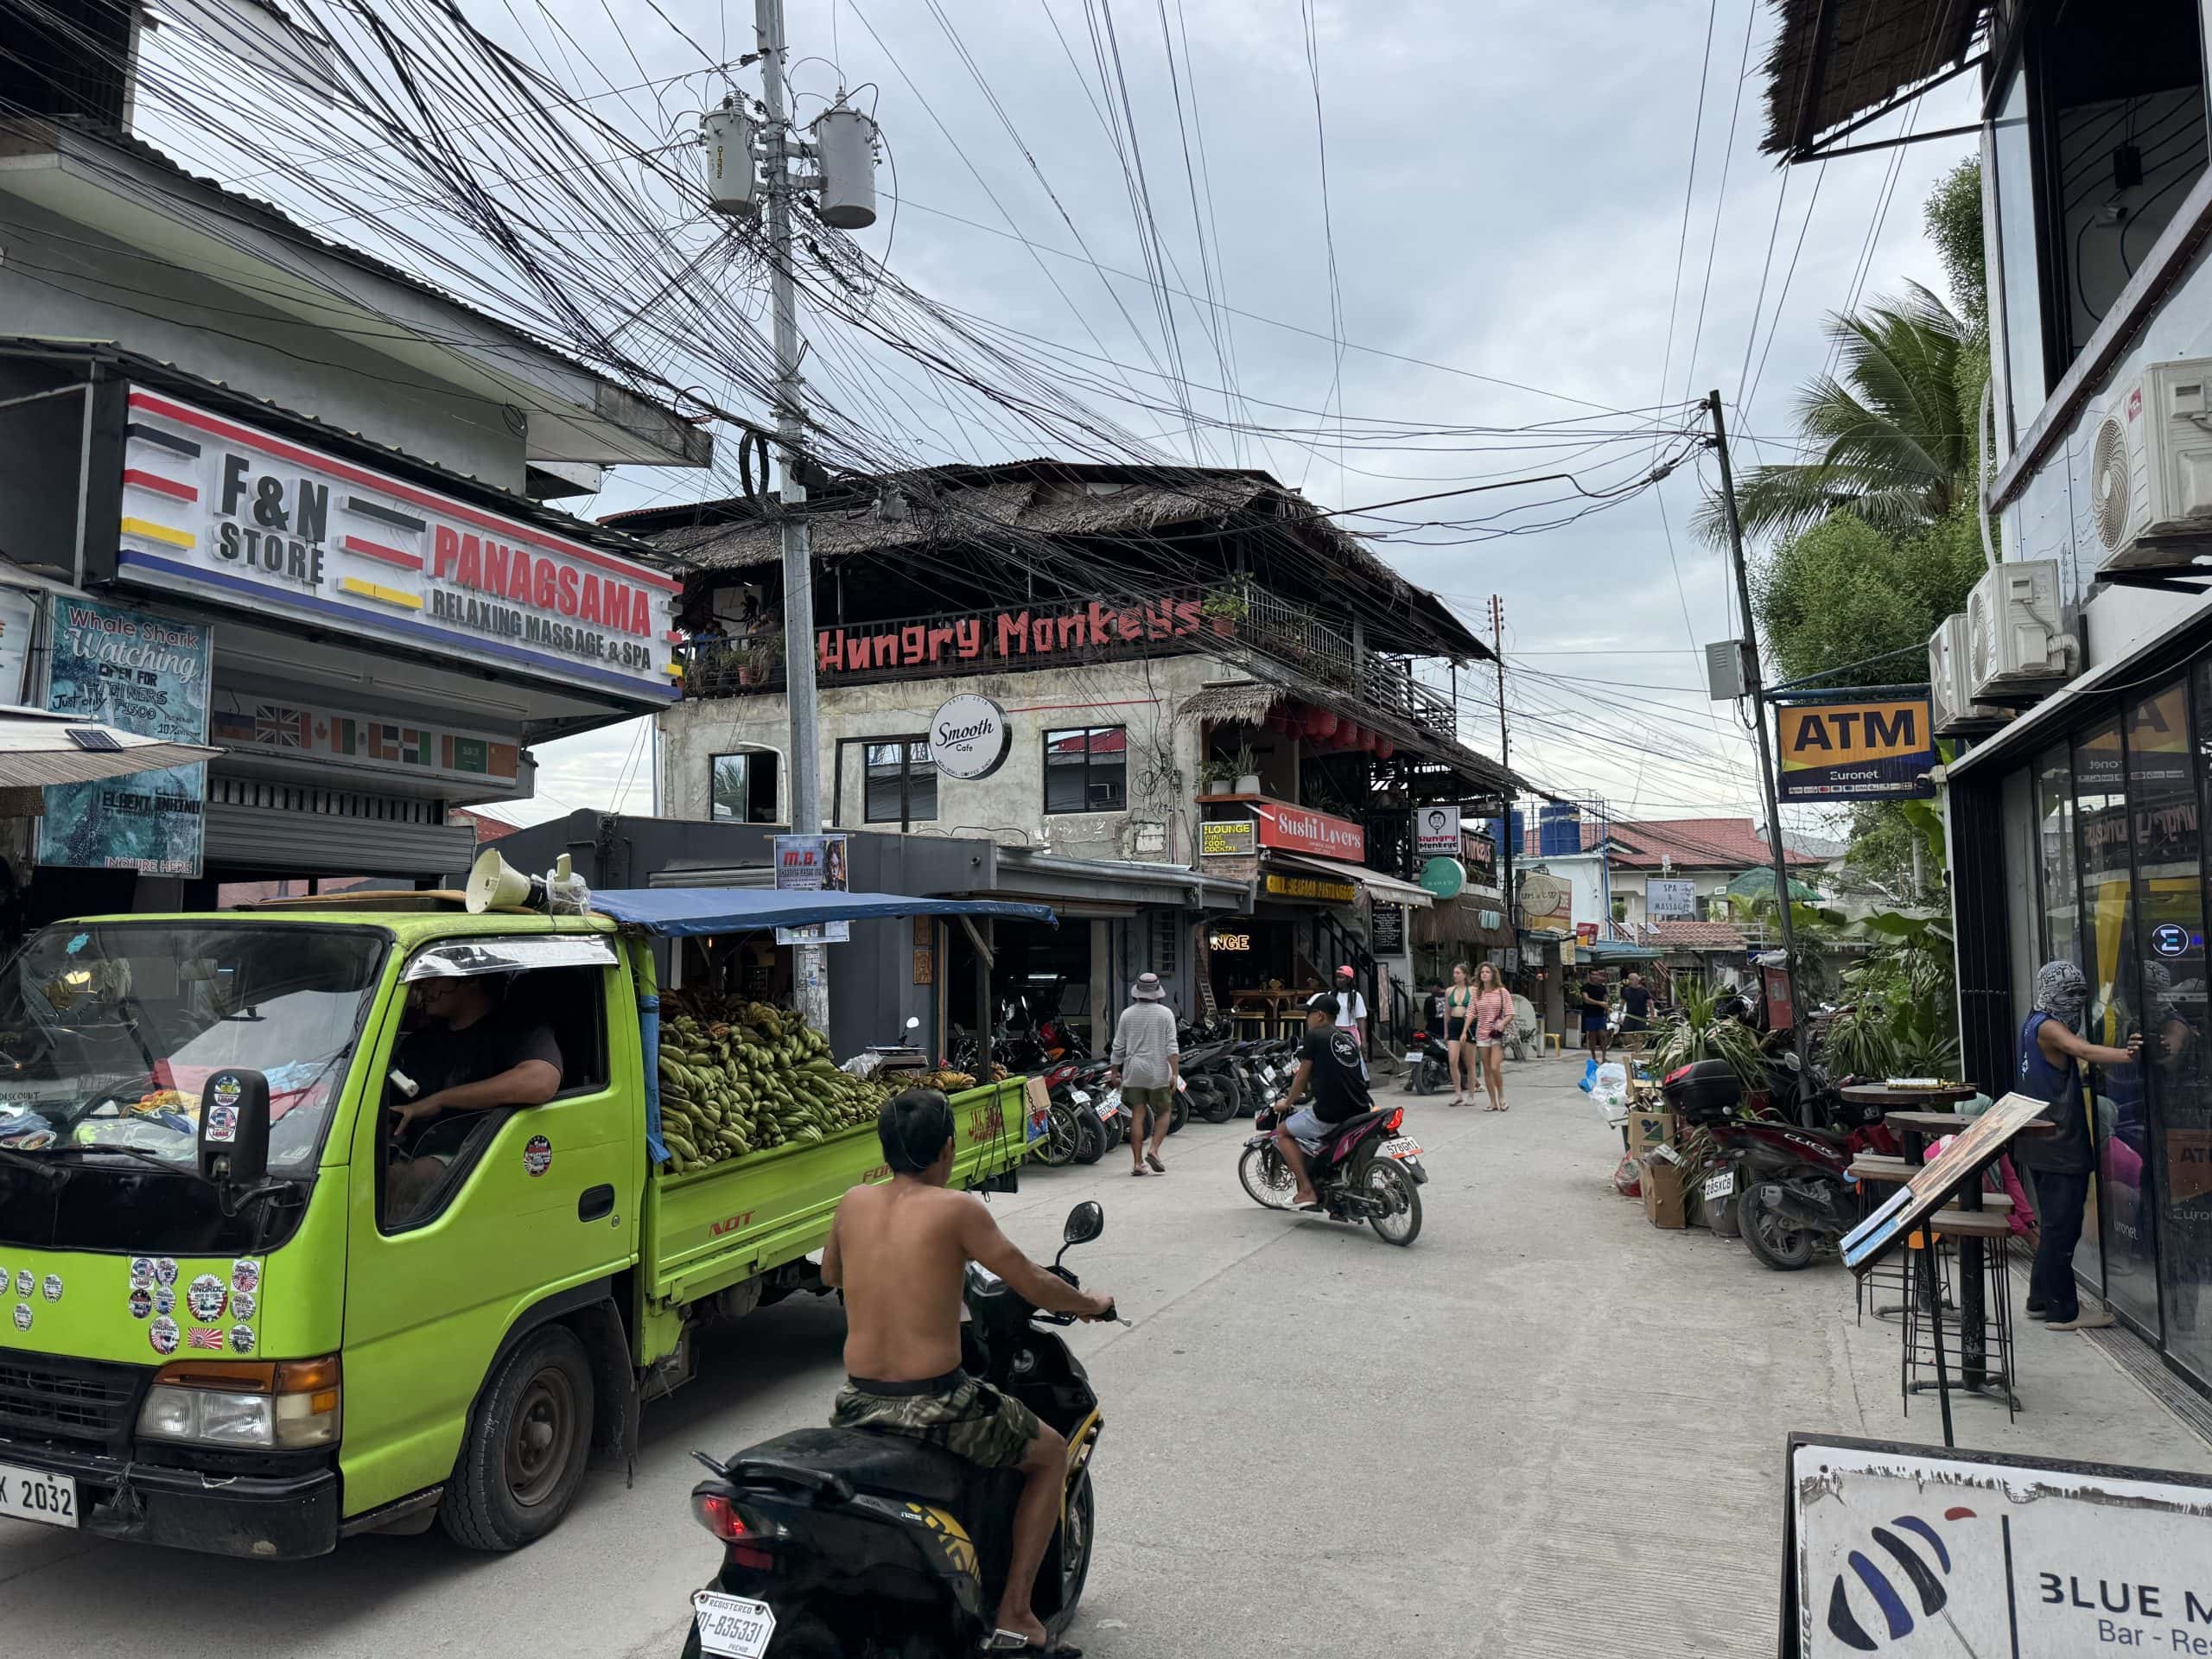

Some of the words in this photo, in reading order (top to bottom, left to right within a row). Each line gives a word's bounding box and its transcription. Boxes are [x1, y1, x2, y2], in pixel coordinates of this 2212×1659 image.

[222, 453, 328, 543] F&N
[219, 522, 324, 584] STORE
[434, 524, 652, 638] PANAGSAMA
[69, 606, 137, 637] Whale
[142, 621, 200, 650] Shark
[433, 588, 522, 635] RELAXING
[525, 614, 604, 658] MASSAGE
[608, 641, 620, 658] &
[622, 641, 652, 670] SPA
[818, 620, 981, 671] Hungry
[997, 598, 1202, 656] Monkeys
[64, 627, 200, 684] Watching
[99, 663, 132, 680] OPEN
[137, 670, 158, 687] FOR
[53, 690, 83, 709] Just
[935, 718, 995, 747] Smooth
[1794, 709, 1916, 751] ATM
[1830, 770, 1879, 781] Euronet
[1208, 823, 1251, 834] LOUNGE
[1279, 812, 1318, 841] Sushi
[1320, 822, 1362, 849] Lovers
[104, 856, 158, 873] INQUIRE
[160, 859, 193, 874] HERE
[1655, 902, 1689, 912] MASSAGE
[1784, 1133, 1834, 1155] CLICK
[2181, 1147, 2212, 1163] AT
[1706, 1177, 1732, 1196] 285XCB
[709, 1210, 756, 1237] NOT
[2173, 1208, 2212, 1222] Euro
[22, 1480, 73, 1516] 2032
[709, 1599, 753, 1614] REGISTERED
[2098, 1618, 2144, 1646] Bar
